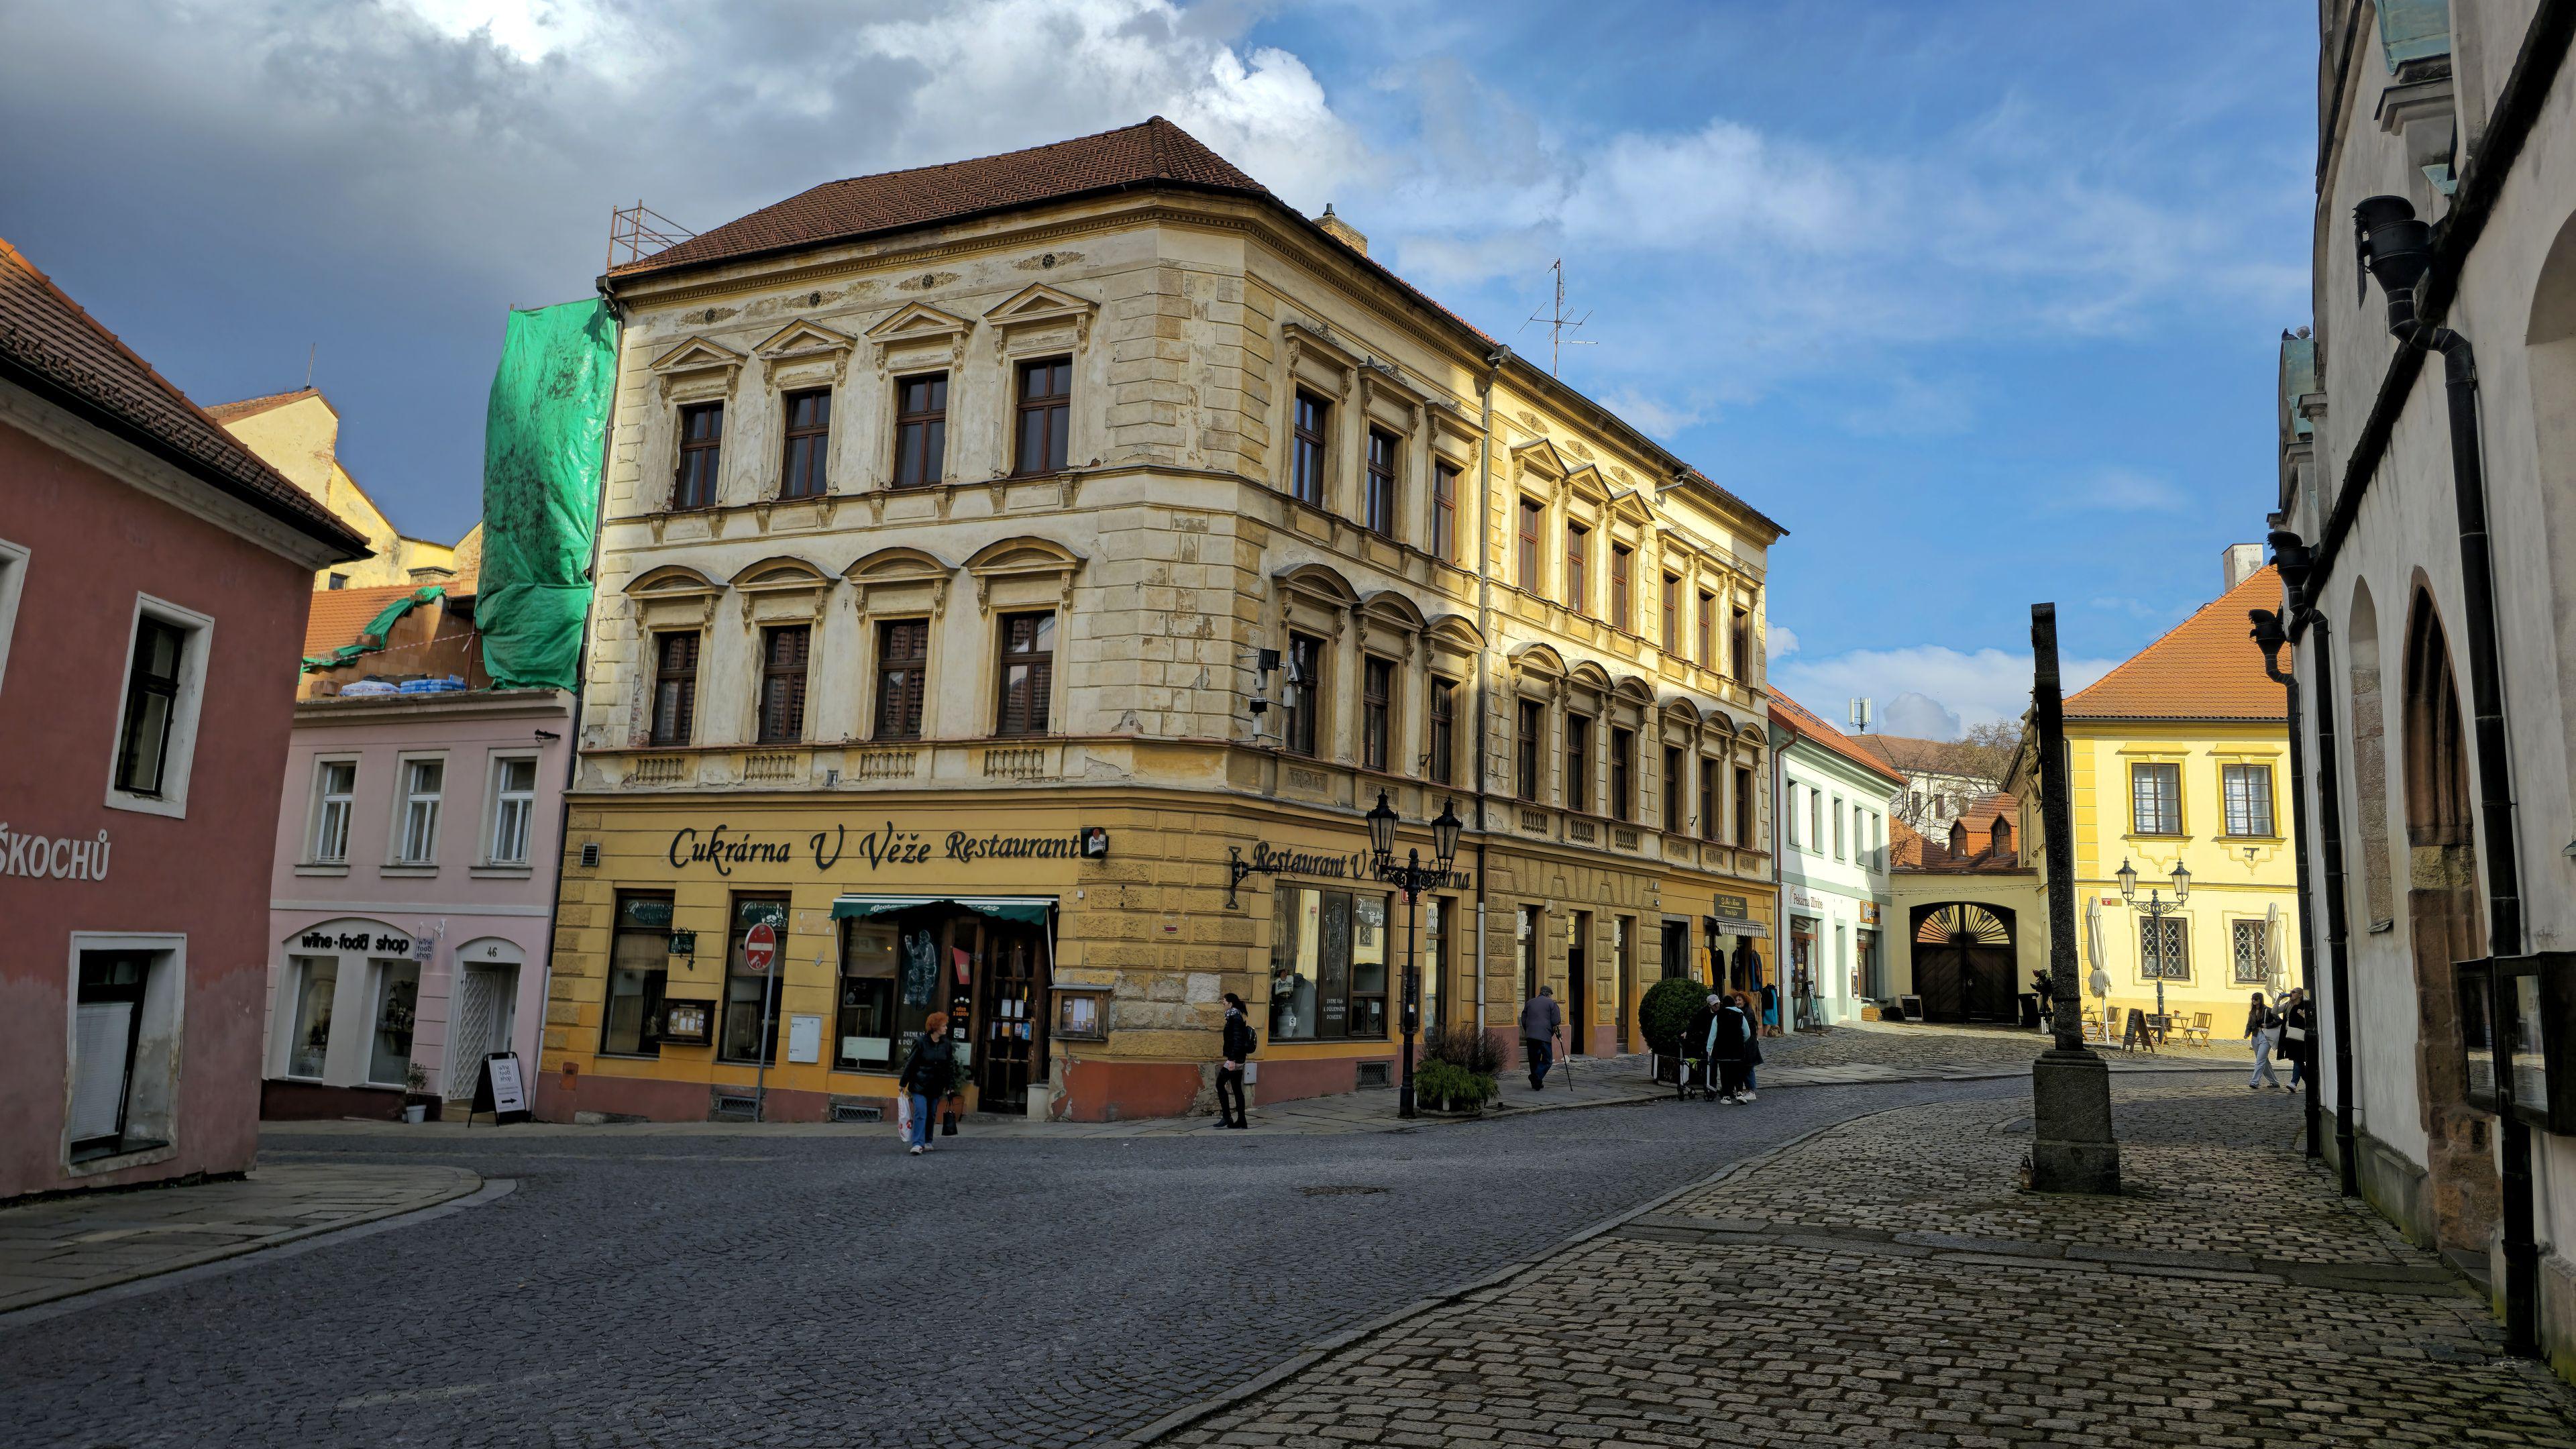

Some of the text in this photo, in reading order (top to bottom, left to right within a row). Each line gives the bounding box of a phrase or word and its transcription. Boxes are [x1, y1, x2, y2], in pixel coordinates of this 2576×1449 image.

[669, 821, 1079, 876] Cukrárna U Věže Restaurant
[1253, 841, 1347, 877] Restaurant
[1350, 848, 1366, 879] U
[376, 934, 409, 955] shop
[487, 947, 498, 957] 46
